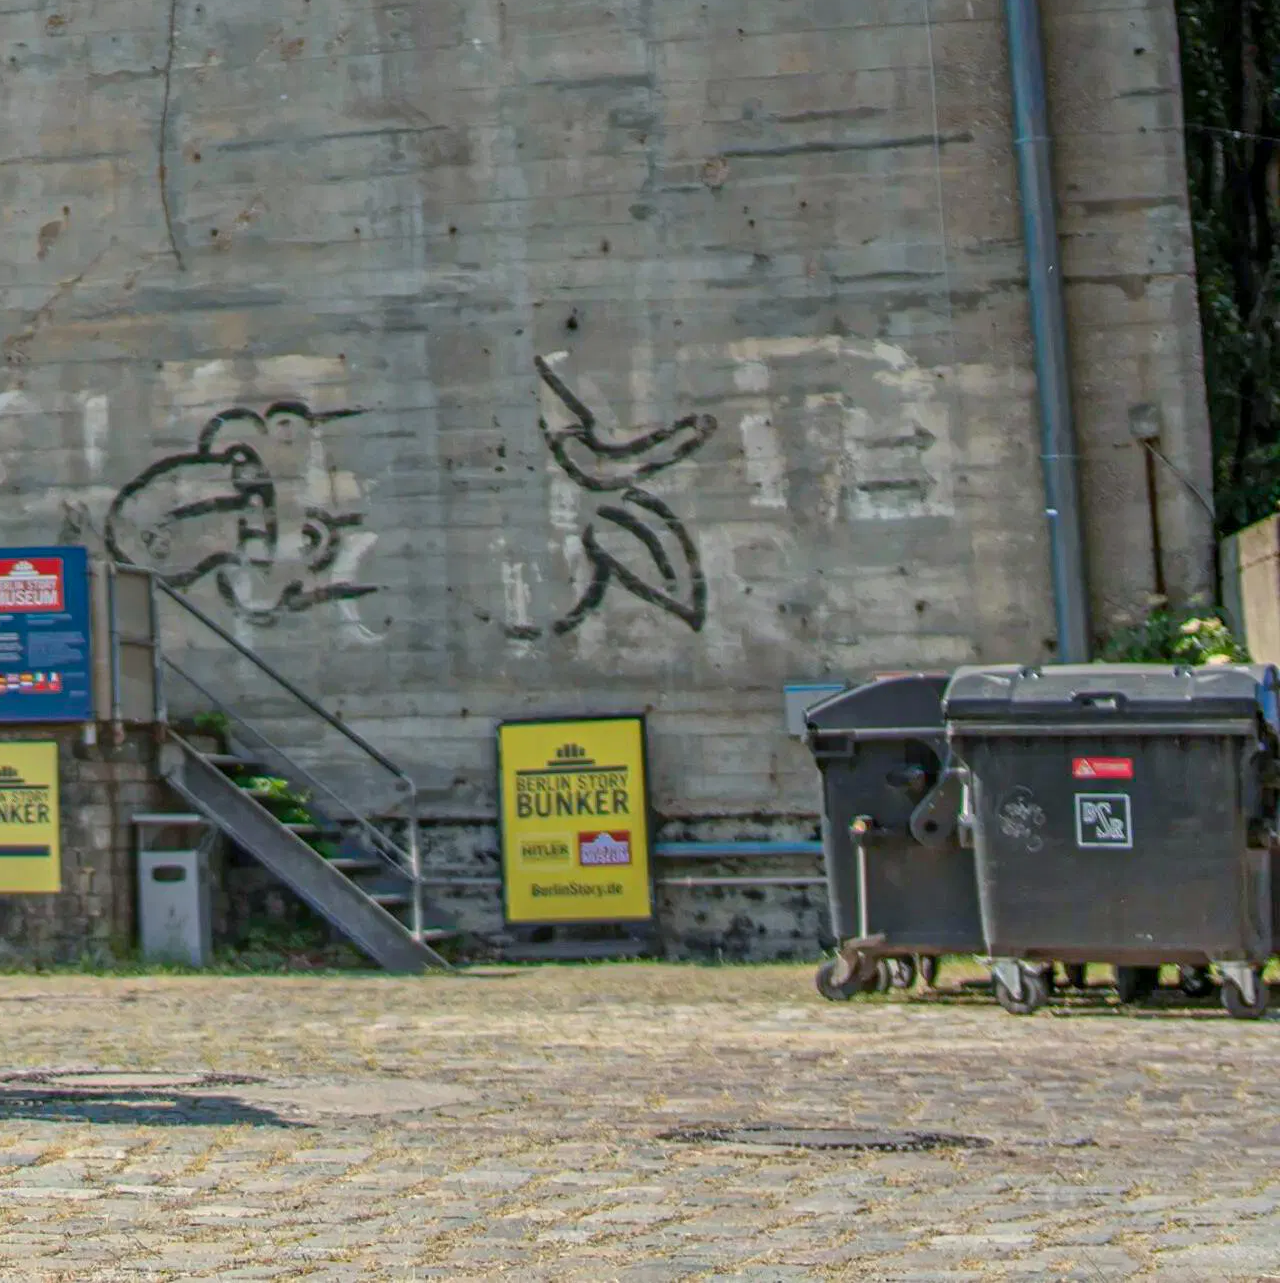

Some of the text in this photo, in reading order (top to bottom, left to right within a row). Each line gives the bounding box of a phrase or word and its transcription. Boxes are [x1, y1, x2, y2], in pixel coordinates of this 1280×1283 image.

[516, 773, 629, 792] BERLIN STORY
[517, 790, 630, 818] BUNKER
[521, 843, 569, 857] HITLER
[530, 881, 624, 897] BerlinStory.de
